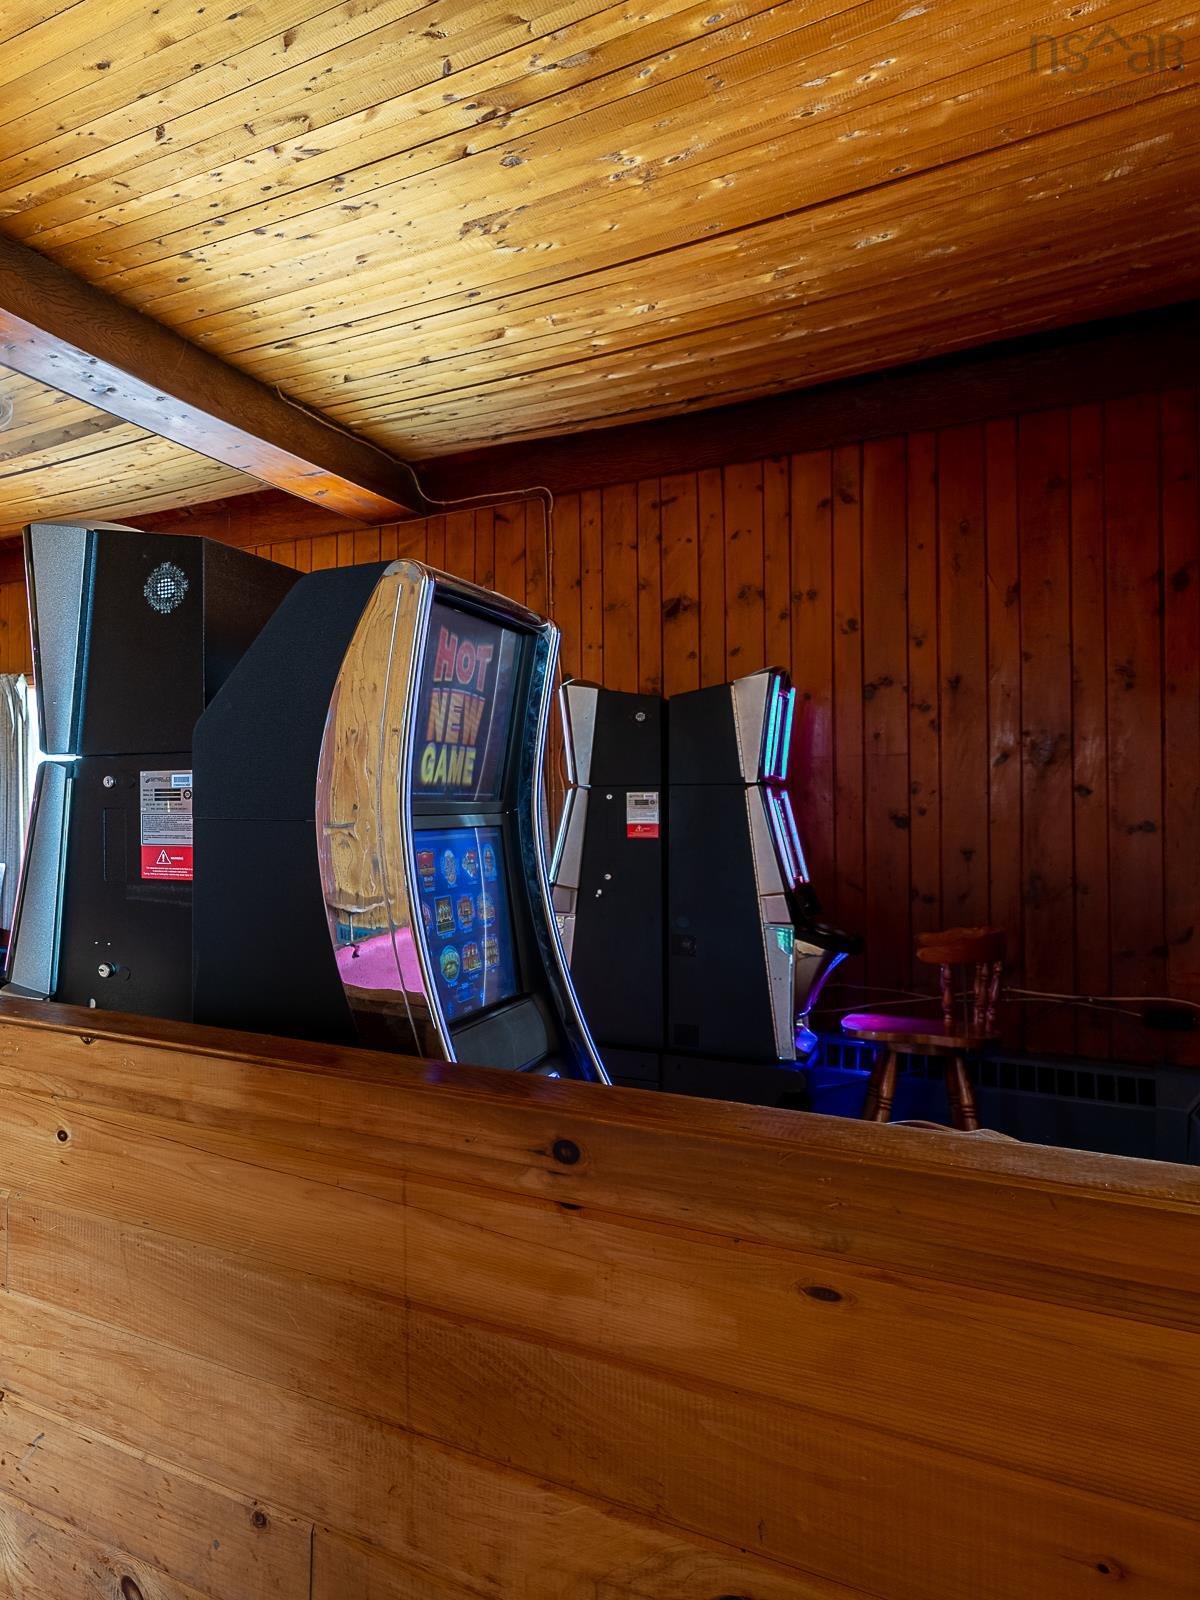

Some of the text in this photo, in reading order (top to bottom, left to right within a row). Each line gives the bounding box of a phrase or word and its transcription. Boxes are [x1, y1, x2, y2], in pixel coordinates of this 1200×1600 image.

[433, 625, 493, 693] HOT
[426, 688, 486, 746] NEW
[420, 743, 477, 786] GAME
